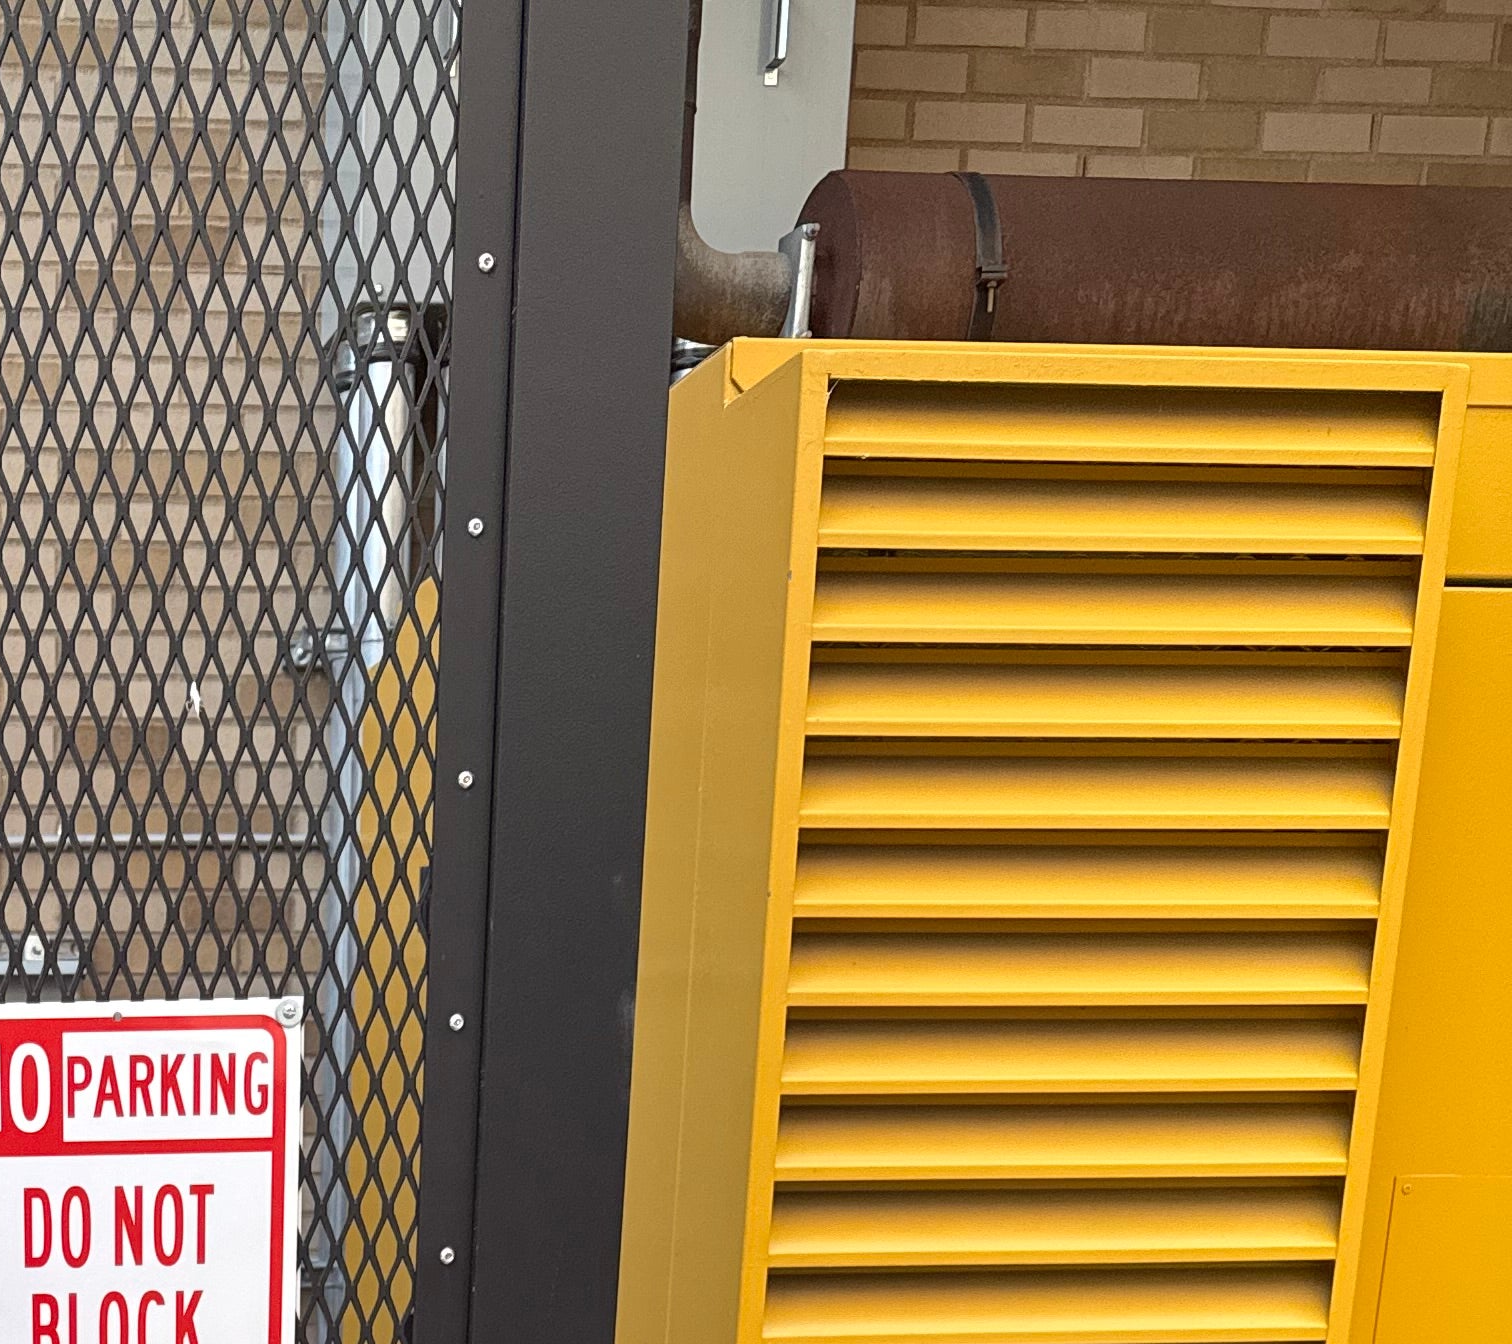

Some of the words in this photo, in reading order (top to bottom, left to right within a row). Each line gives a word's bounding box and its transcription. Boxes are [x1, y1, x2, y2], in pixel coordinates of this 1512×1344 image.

[67, 1052, 269, 1118] PARKING
[23, 1186, 92, 1269] DO
[114, 1183, 215, 1267] NOT
